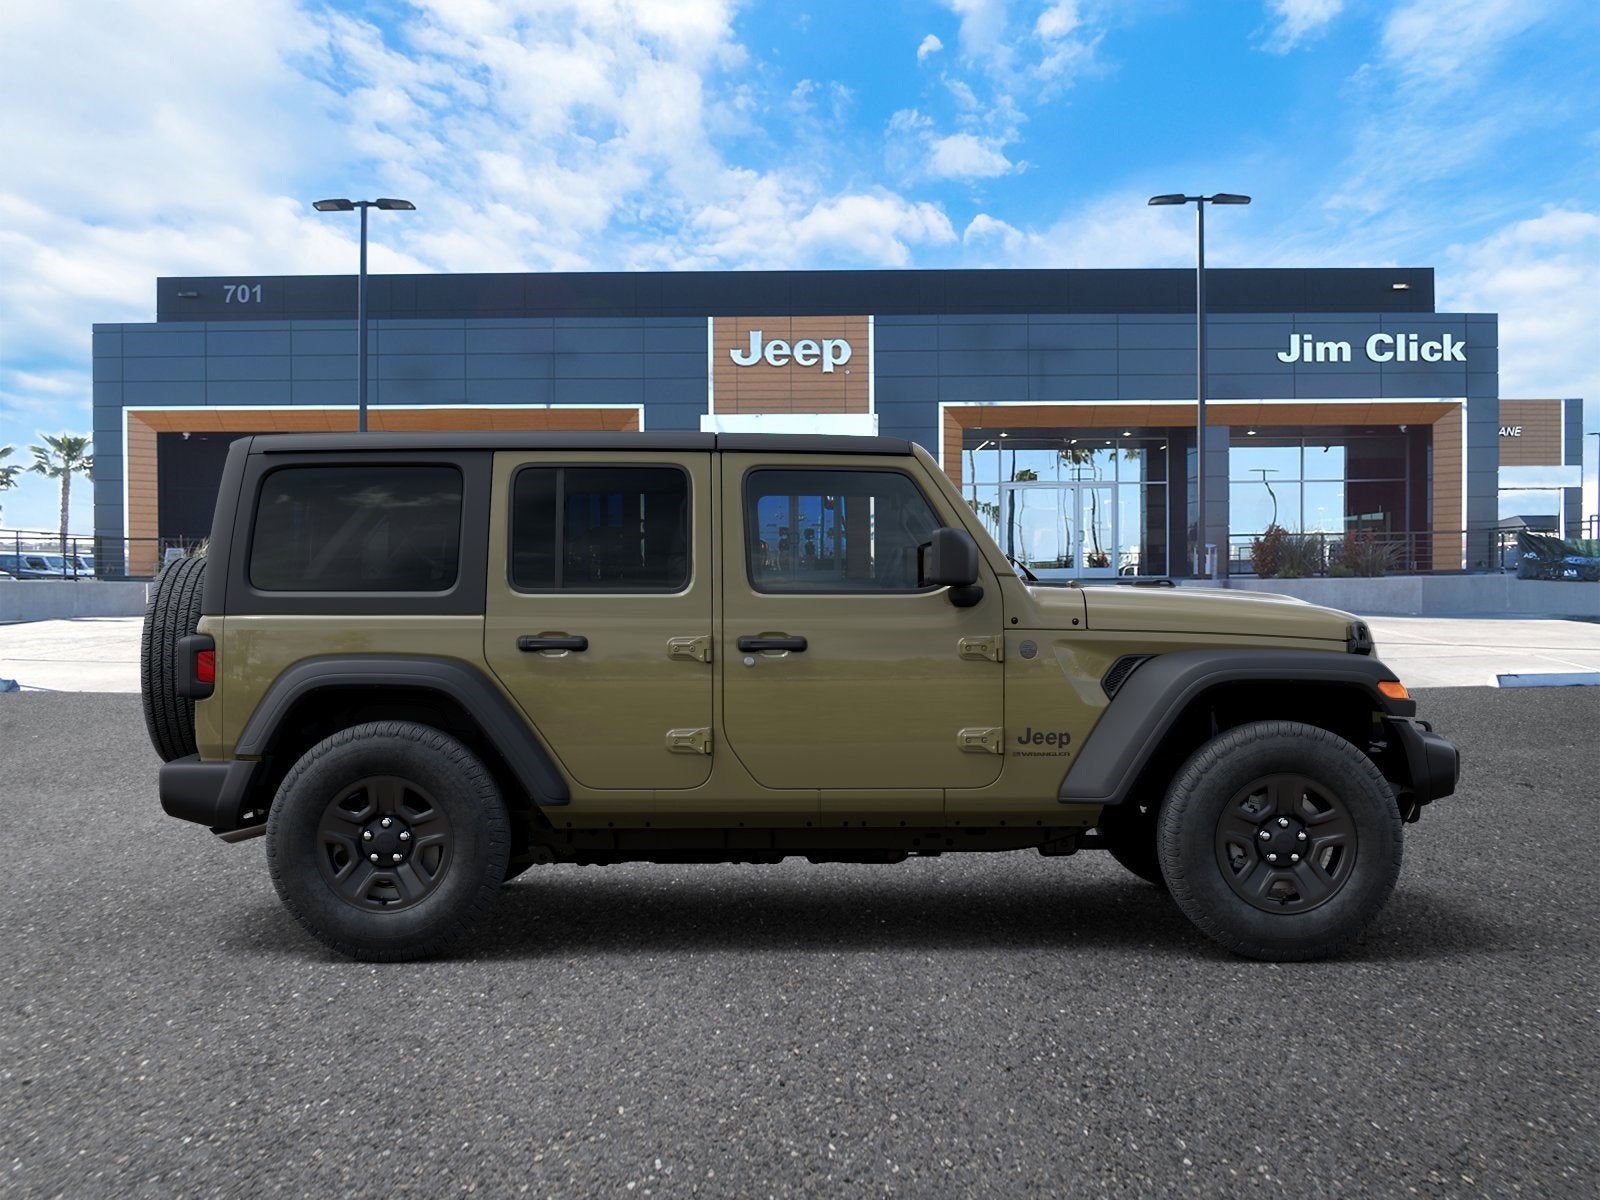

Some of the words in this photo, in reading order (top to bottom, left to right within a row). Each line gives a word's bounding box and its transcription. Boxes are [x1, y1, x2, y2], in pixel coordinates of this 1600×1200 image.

[223, 284, 262, 303] 701
[729, 330, 852, 373] Jeep
[1277, 333, 1351, 363] Jim
[1366, 333, 1467, 362] Click
[1017, 727, 1071, 748] Jeep
